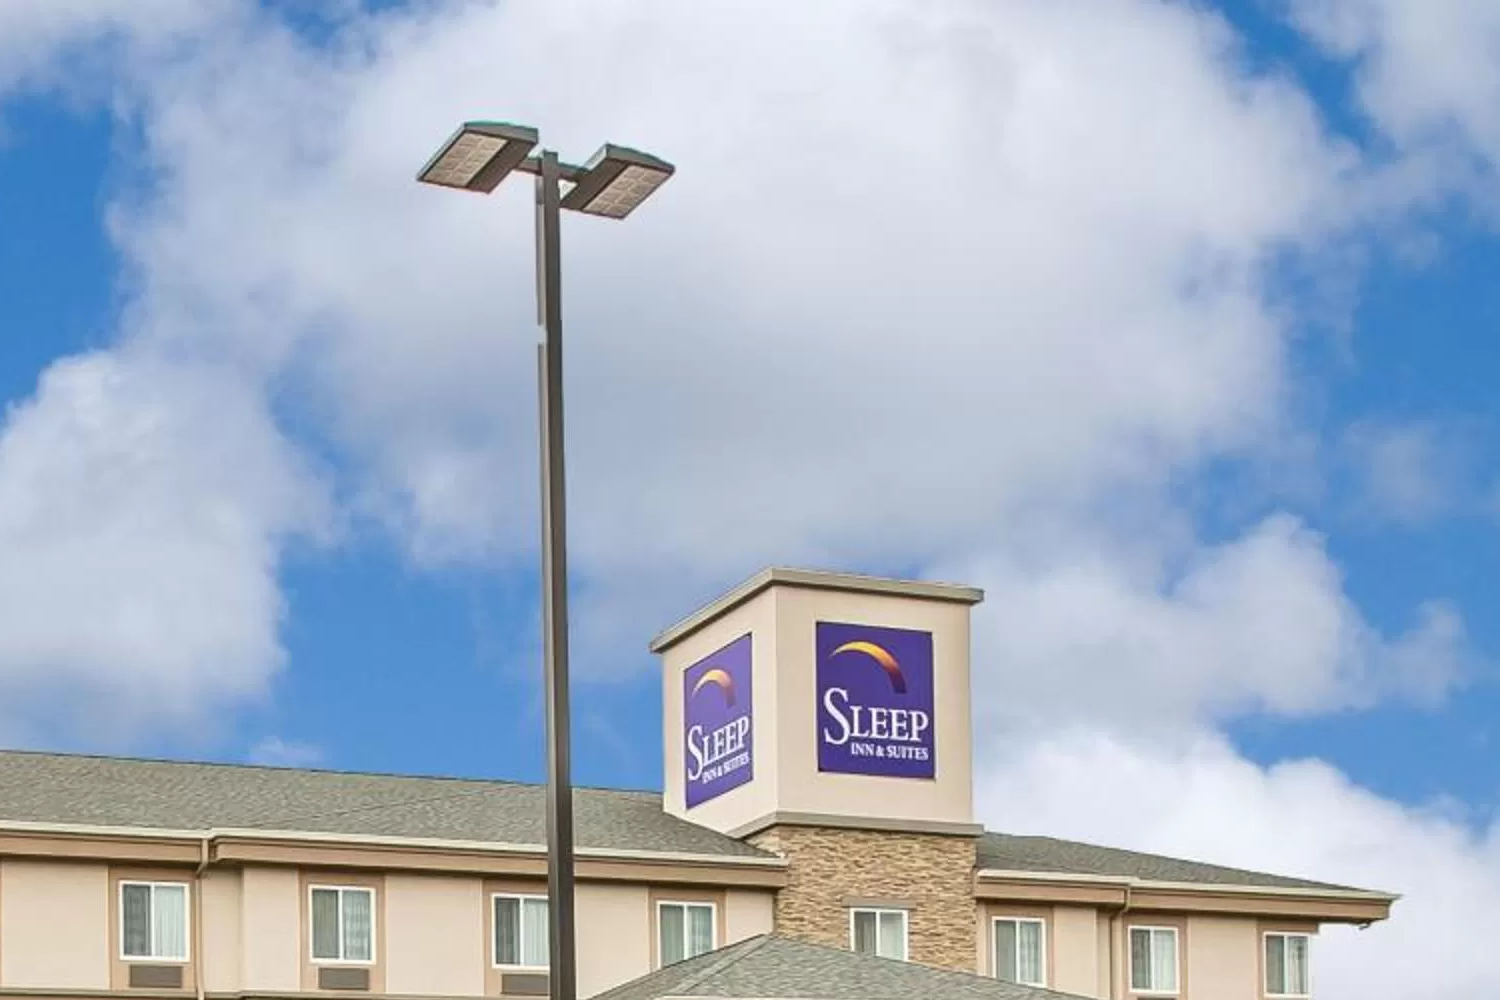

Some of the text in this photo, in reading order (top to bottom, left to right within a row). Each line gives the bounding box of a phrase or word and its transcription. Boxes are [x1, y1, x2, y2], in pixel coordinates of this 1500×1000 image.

[824, 687, 929, 745] SLEEP
[687, 716, 749, 781] SLEEP
[850, 742, 928, 761] INN & SUITES
